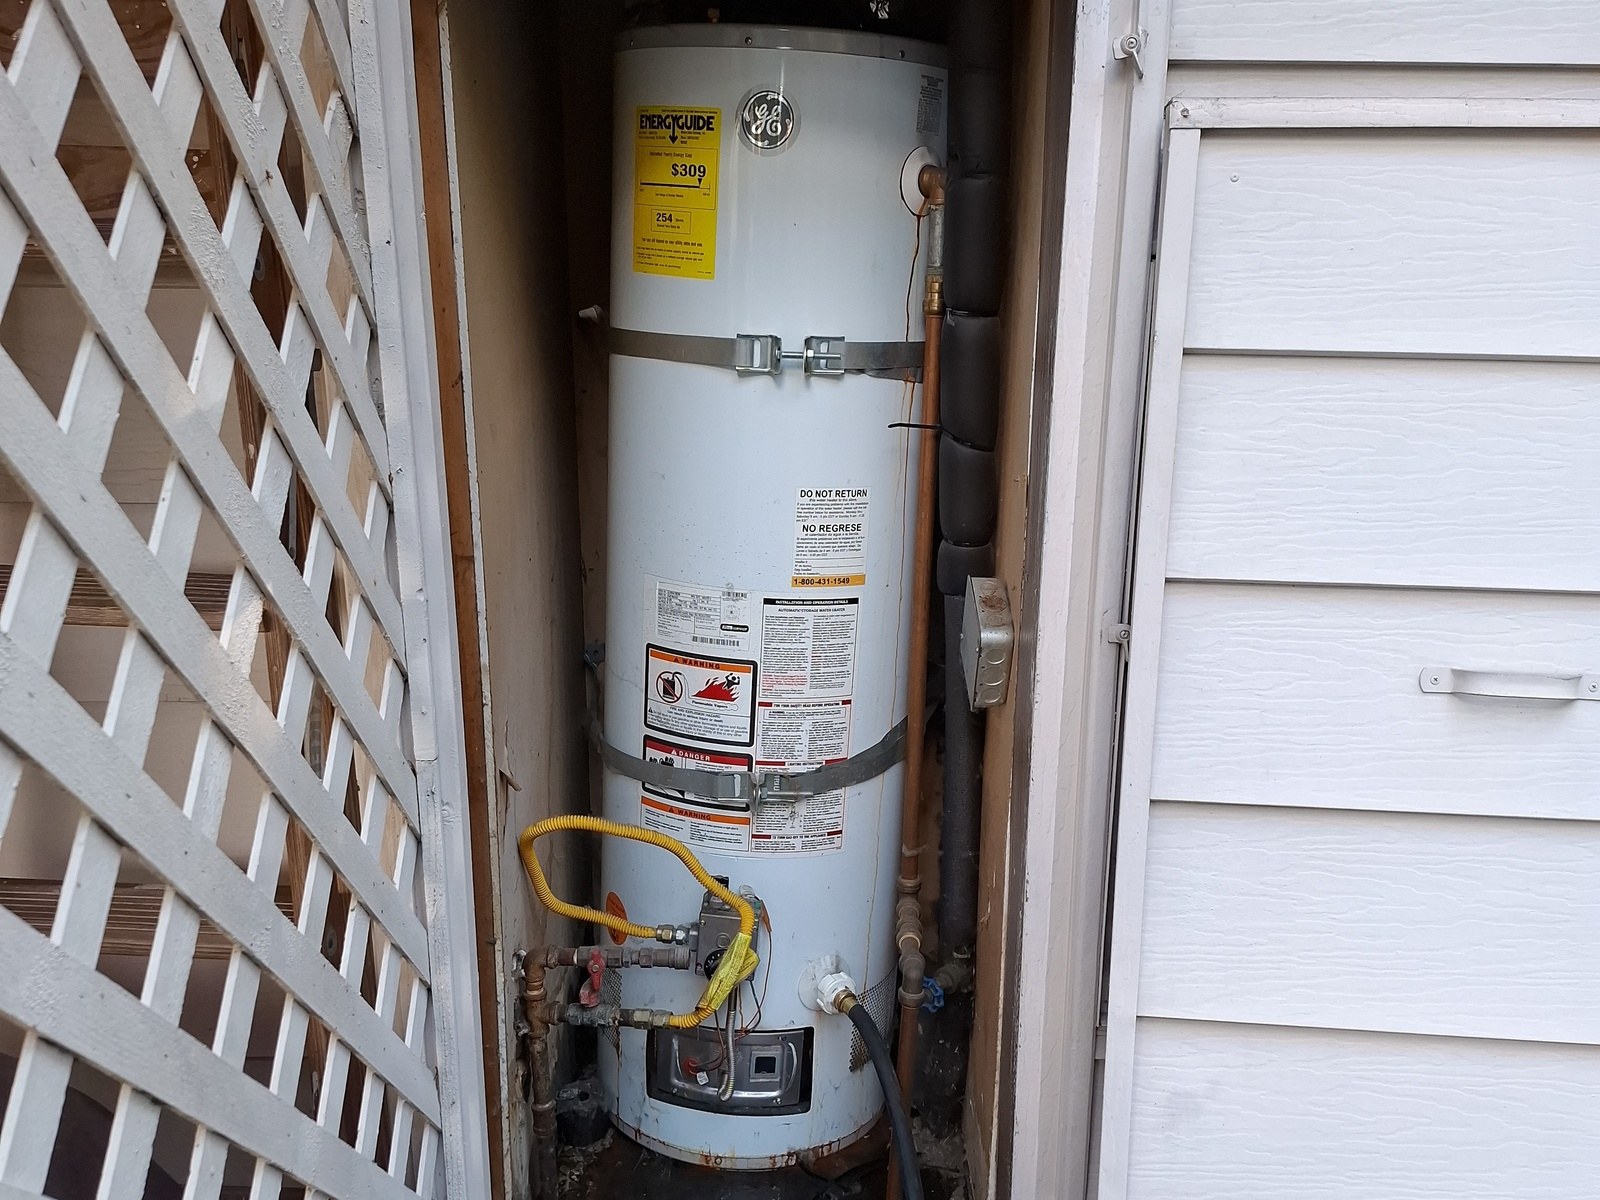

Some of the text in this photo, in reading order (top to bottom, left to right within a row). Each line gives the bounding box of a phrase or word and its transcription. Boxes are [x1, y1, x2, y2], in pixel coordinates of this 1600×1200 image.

[639, 114, 715, 131] ENERGYGUIDE
[671, 163, 706, 178] $309
[656, 212, 673, 223] 254
[800, 489, 868, 498] DO NOT RETURN
[802, 523, 862, 532] NO REGRESE
[794, 577, 850, 585] 1-800-431-1549
[682, 658, 720, 669] WARNING
[679, 750, 710, 761] DANGER
[679, 810, 711, 820] WARNING
